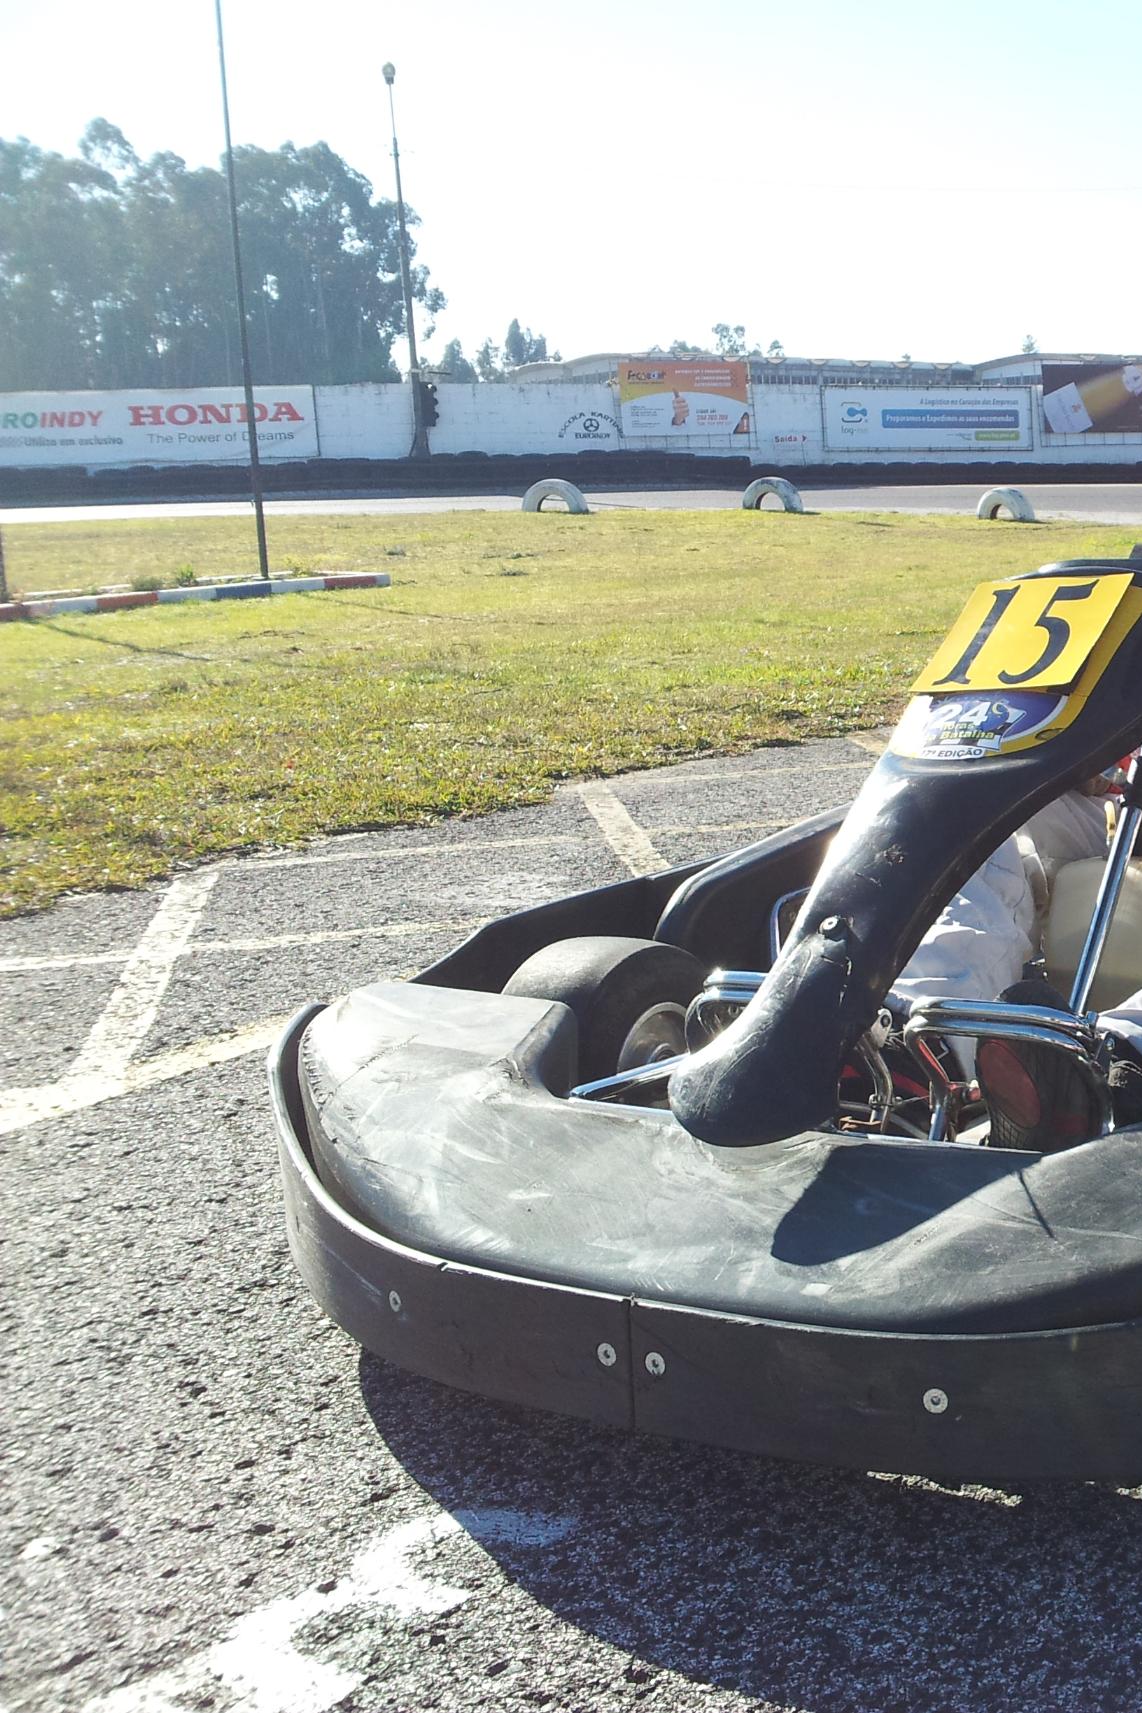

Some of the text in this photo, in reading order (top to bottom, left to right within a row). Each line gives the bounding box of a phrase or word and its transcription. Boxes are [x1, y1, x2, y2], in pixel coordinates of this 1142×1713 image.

[0, 411, 102, 428] ROINDY
[128, 402, 305, 426] HONDA
[147, 431, 295, 444] The Power of Deams
[931, 579, 1100, 686] 15
[930, 701, 990, 726] 24
[940, 730, 996, 740] Batalha
[937, 747, 983, 758] EDIÇÃO
